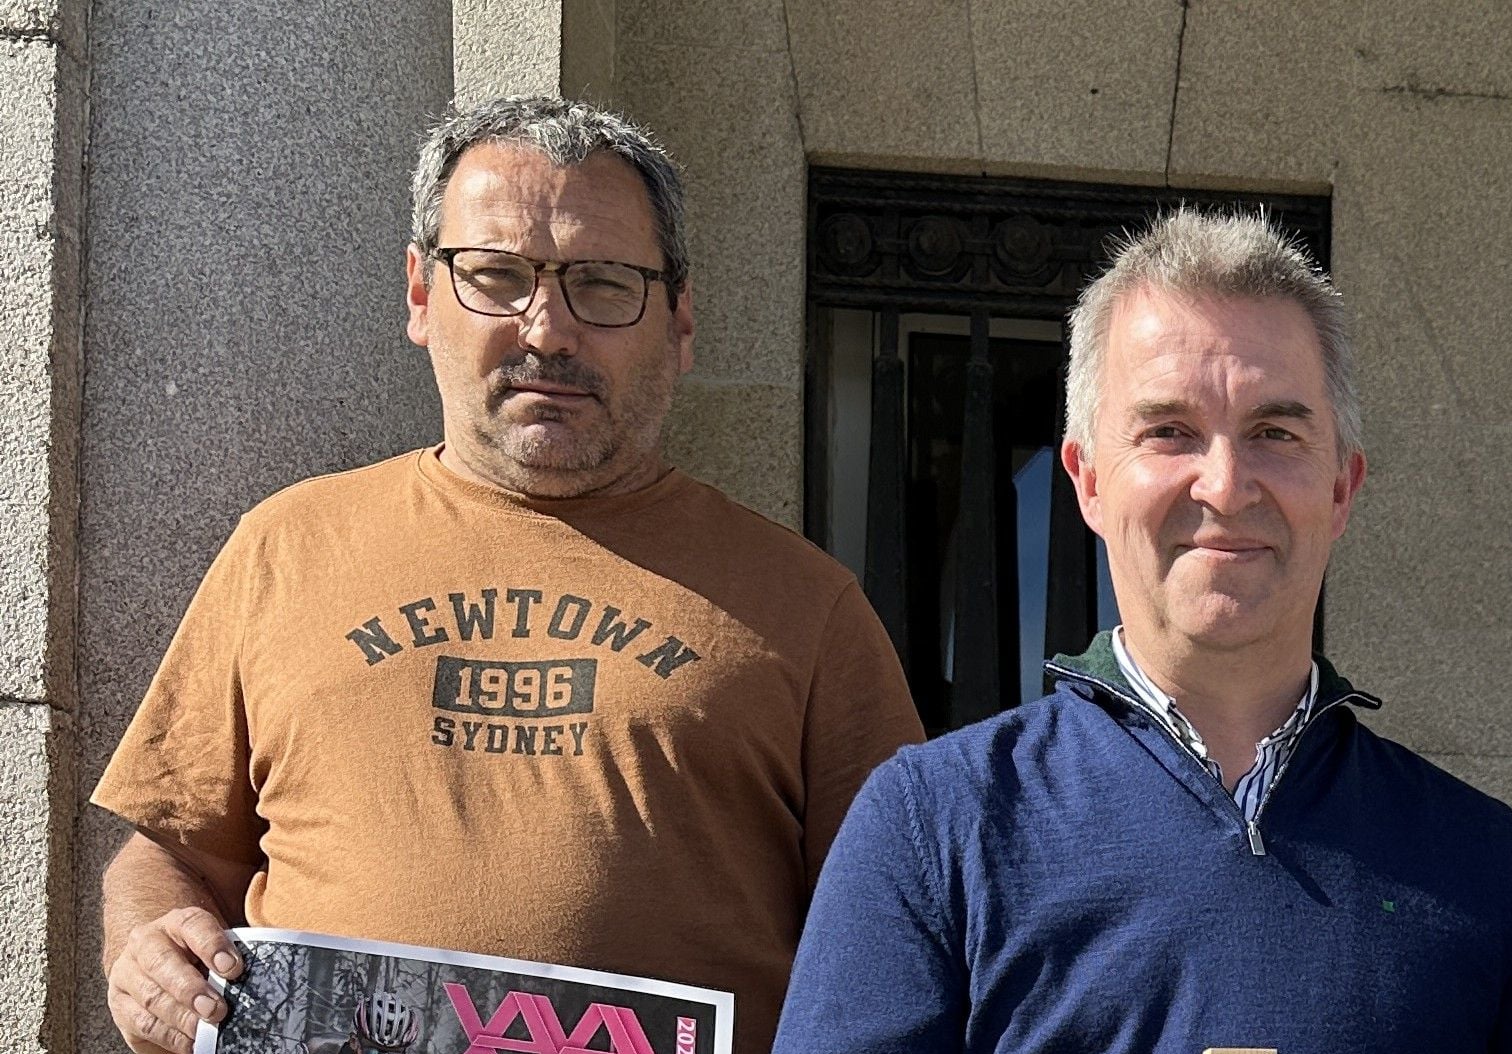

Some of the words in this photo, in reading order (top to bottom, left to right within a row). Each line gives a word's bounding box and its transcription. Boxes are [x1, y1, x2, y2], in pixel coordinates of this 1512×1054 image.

[345, 588, 701, 680] NEWTOWN
[456, 666, 572, 710] 1996
[432, 717, 589, 757] SYDNEY
